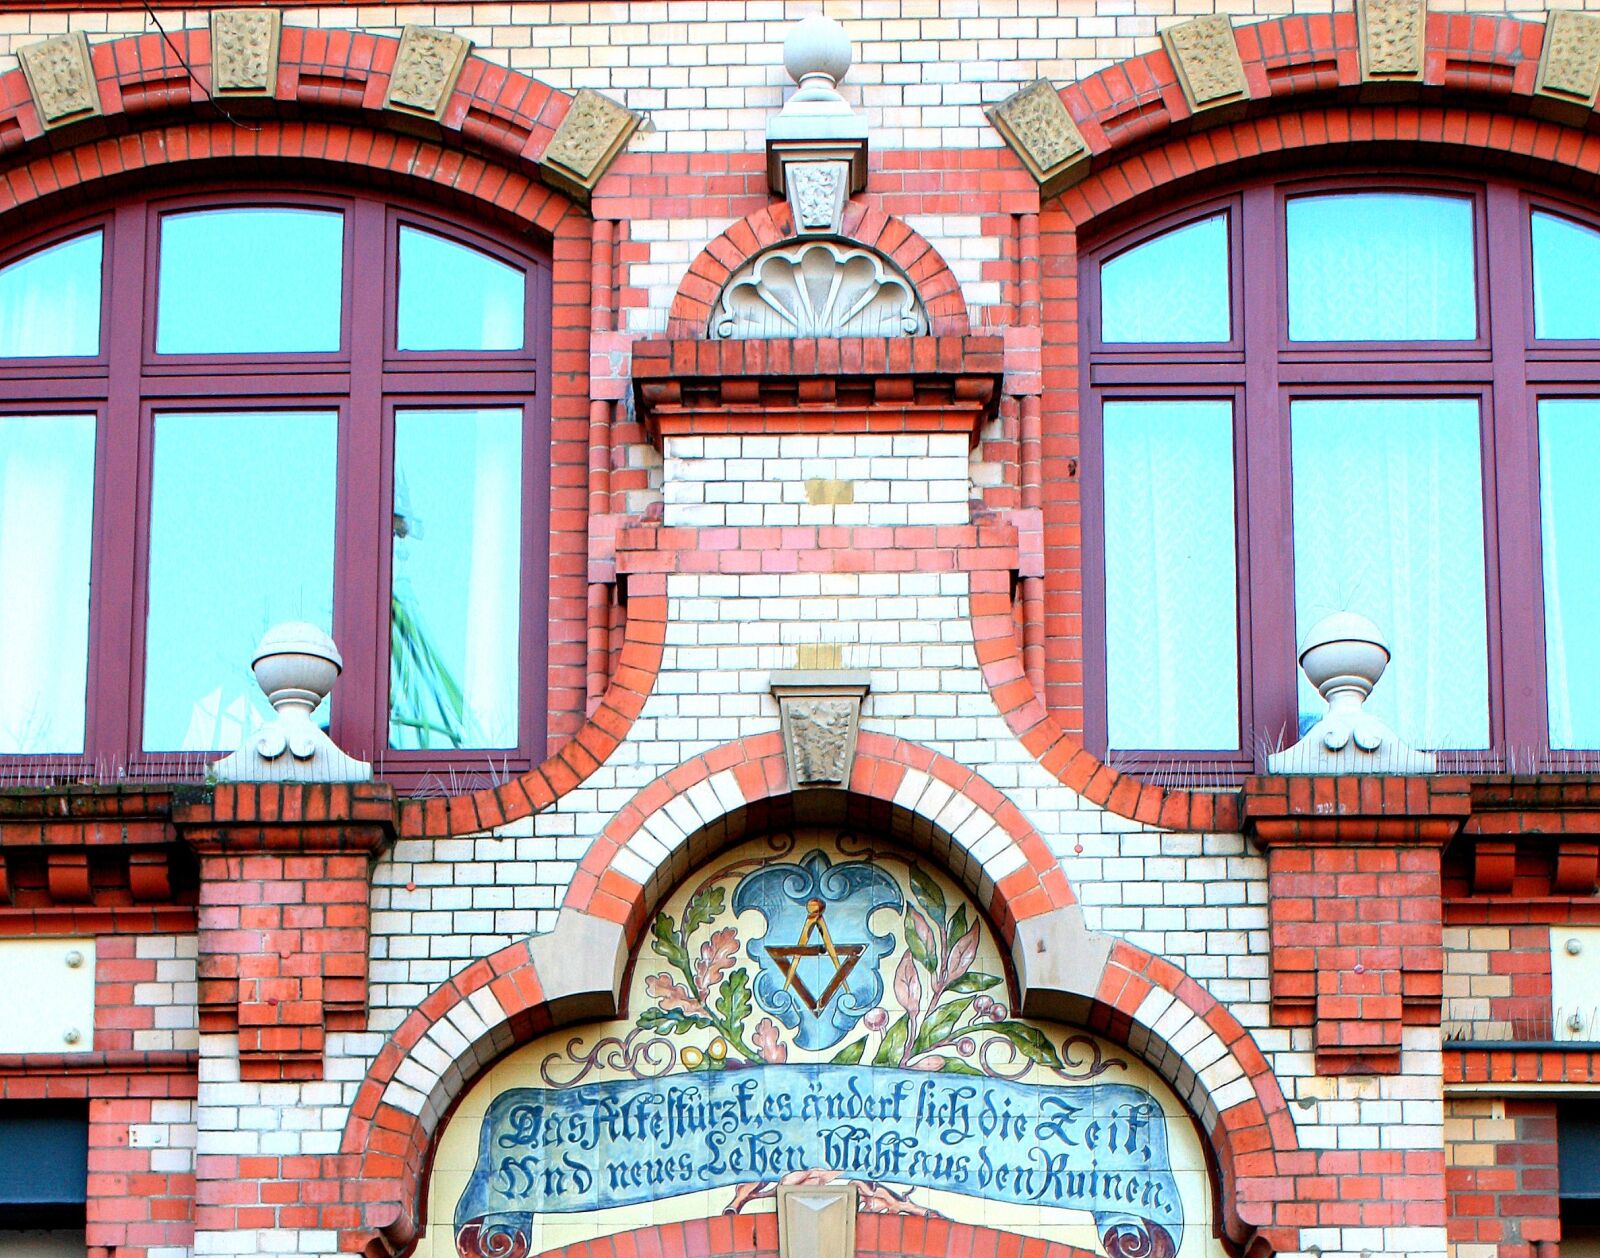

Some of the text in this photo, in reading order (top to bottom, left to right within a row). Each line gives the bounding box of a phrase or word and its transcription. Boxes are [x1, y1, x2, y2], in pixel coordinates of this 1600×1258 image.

[498, 1104, 586, 1149] Das
[578, 1090, 664, 1150] Alte
[763, 1093, 793, 1122] es
[801, 1075, 914, 1123] ändert
[978, 1092, 1027, 1143] die
[1034, 1097, 1153, 1162] Zeit,
[493, 1124, 1173, 1214] Und neues Leben blüht aus den Ruinen.
